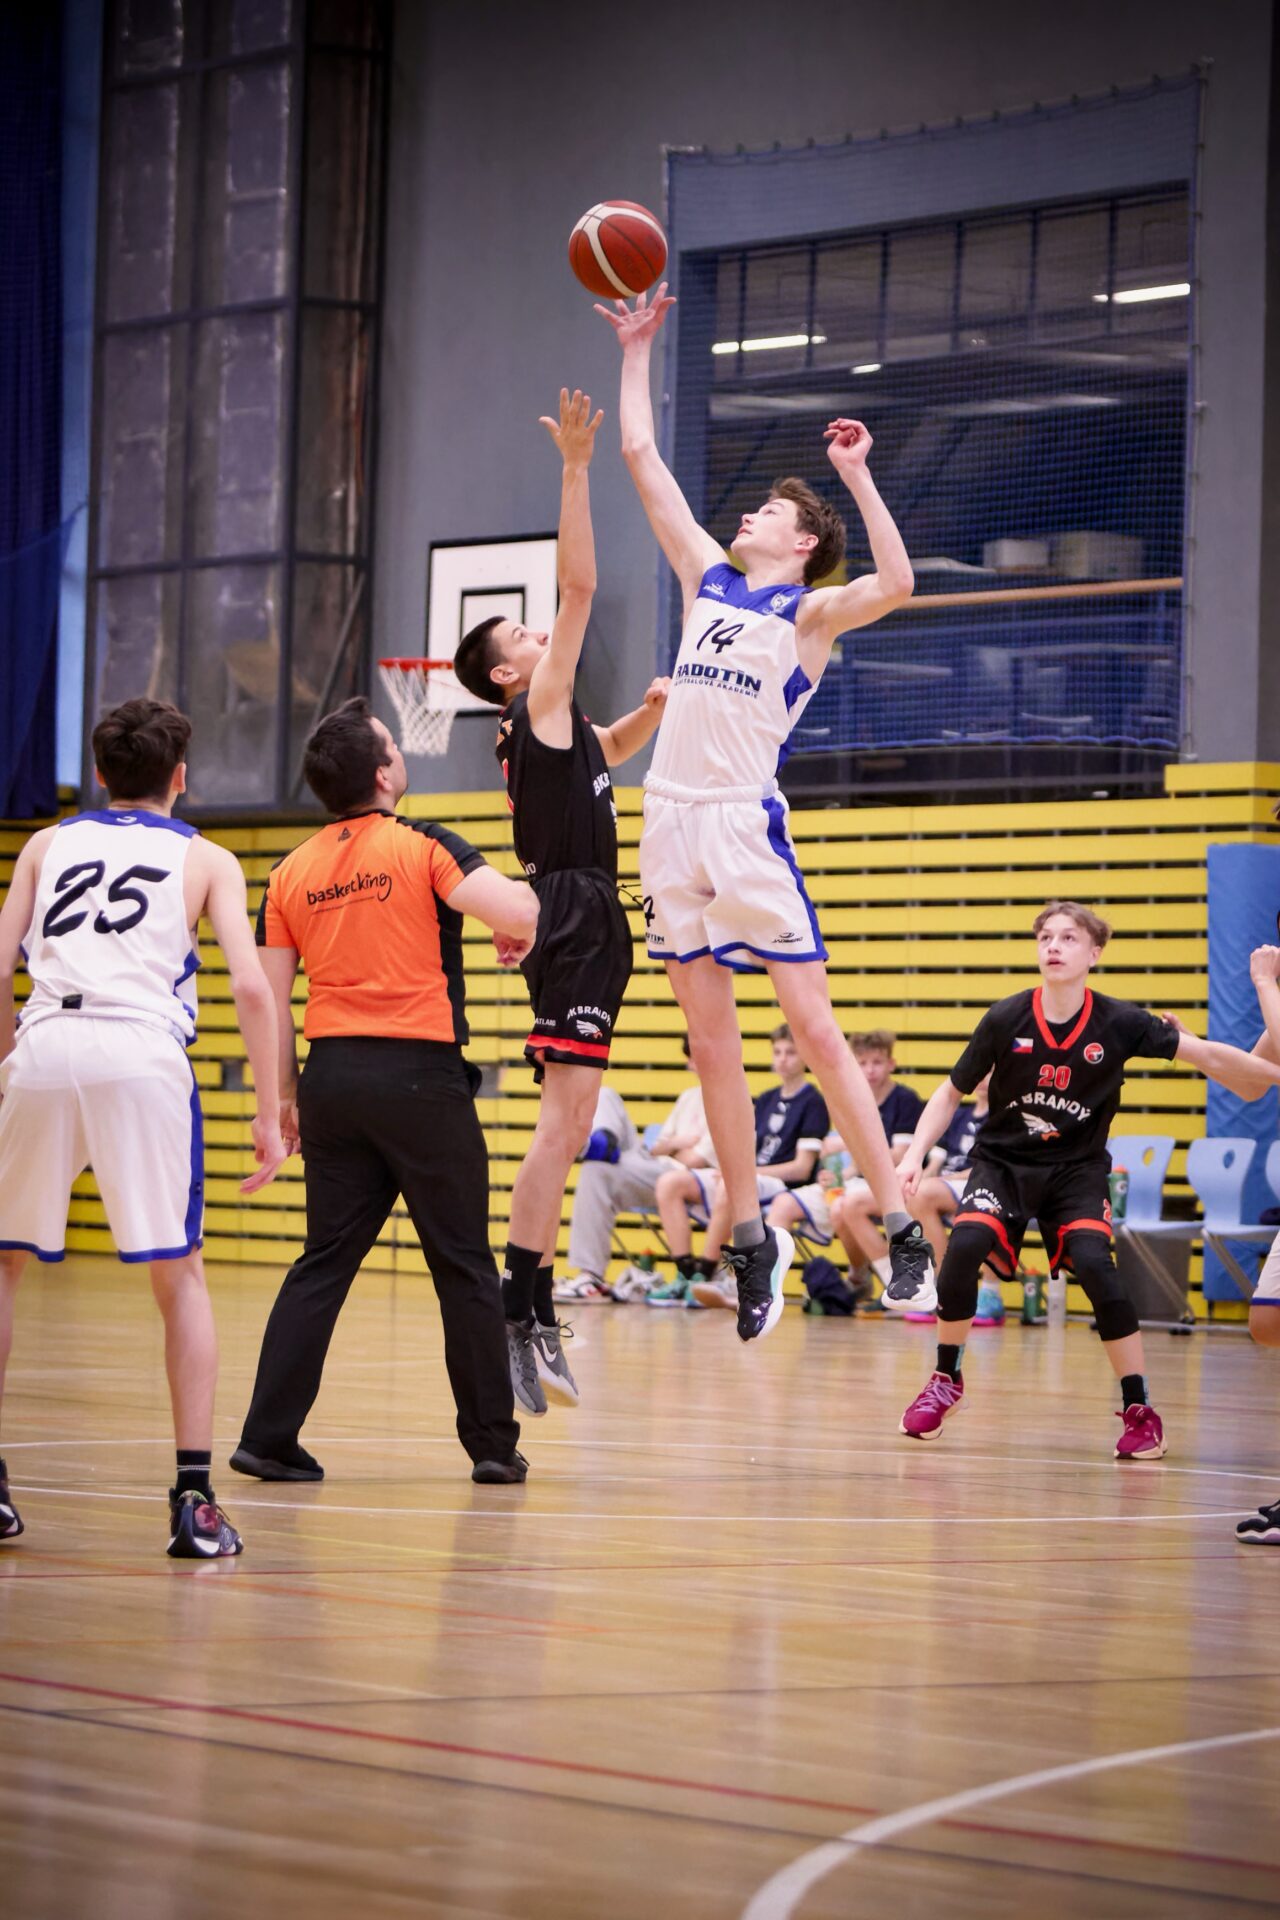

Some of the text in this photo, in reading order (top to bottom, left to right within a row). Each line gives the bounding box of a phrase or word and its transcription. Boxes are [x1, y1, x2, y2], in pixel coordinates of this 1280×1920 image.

[696, 618, 745, 654] 14
[43, 859, 172, 939] 25
[1038, 1064, 1072, 1090] 20
